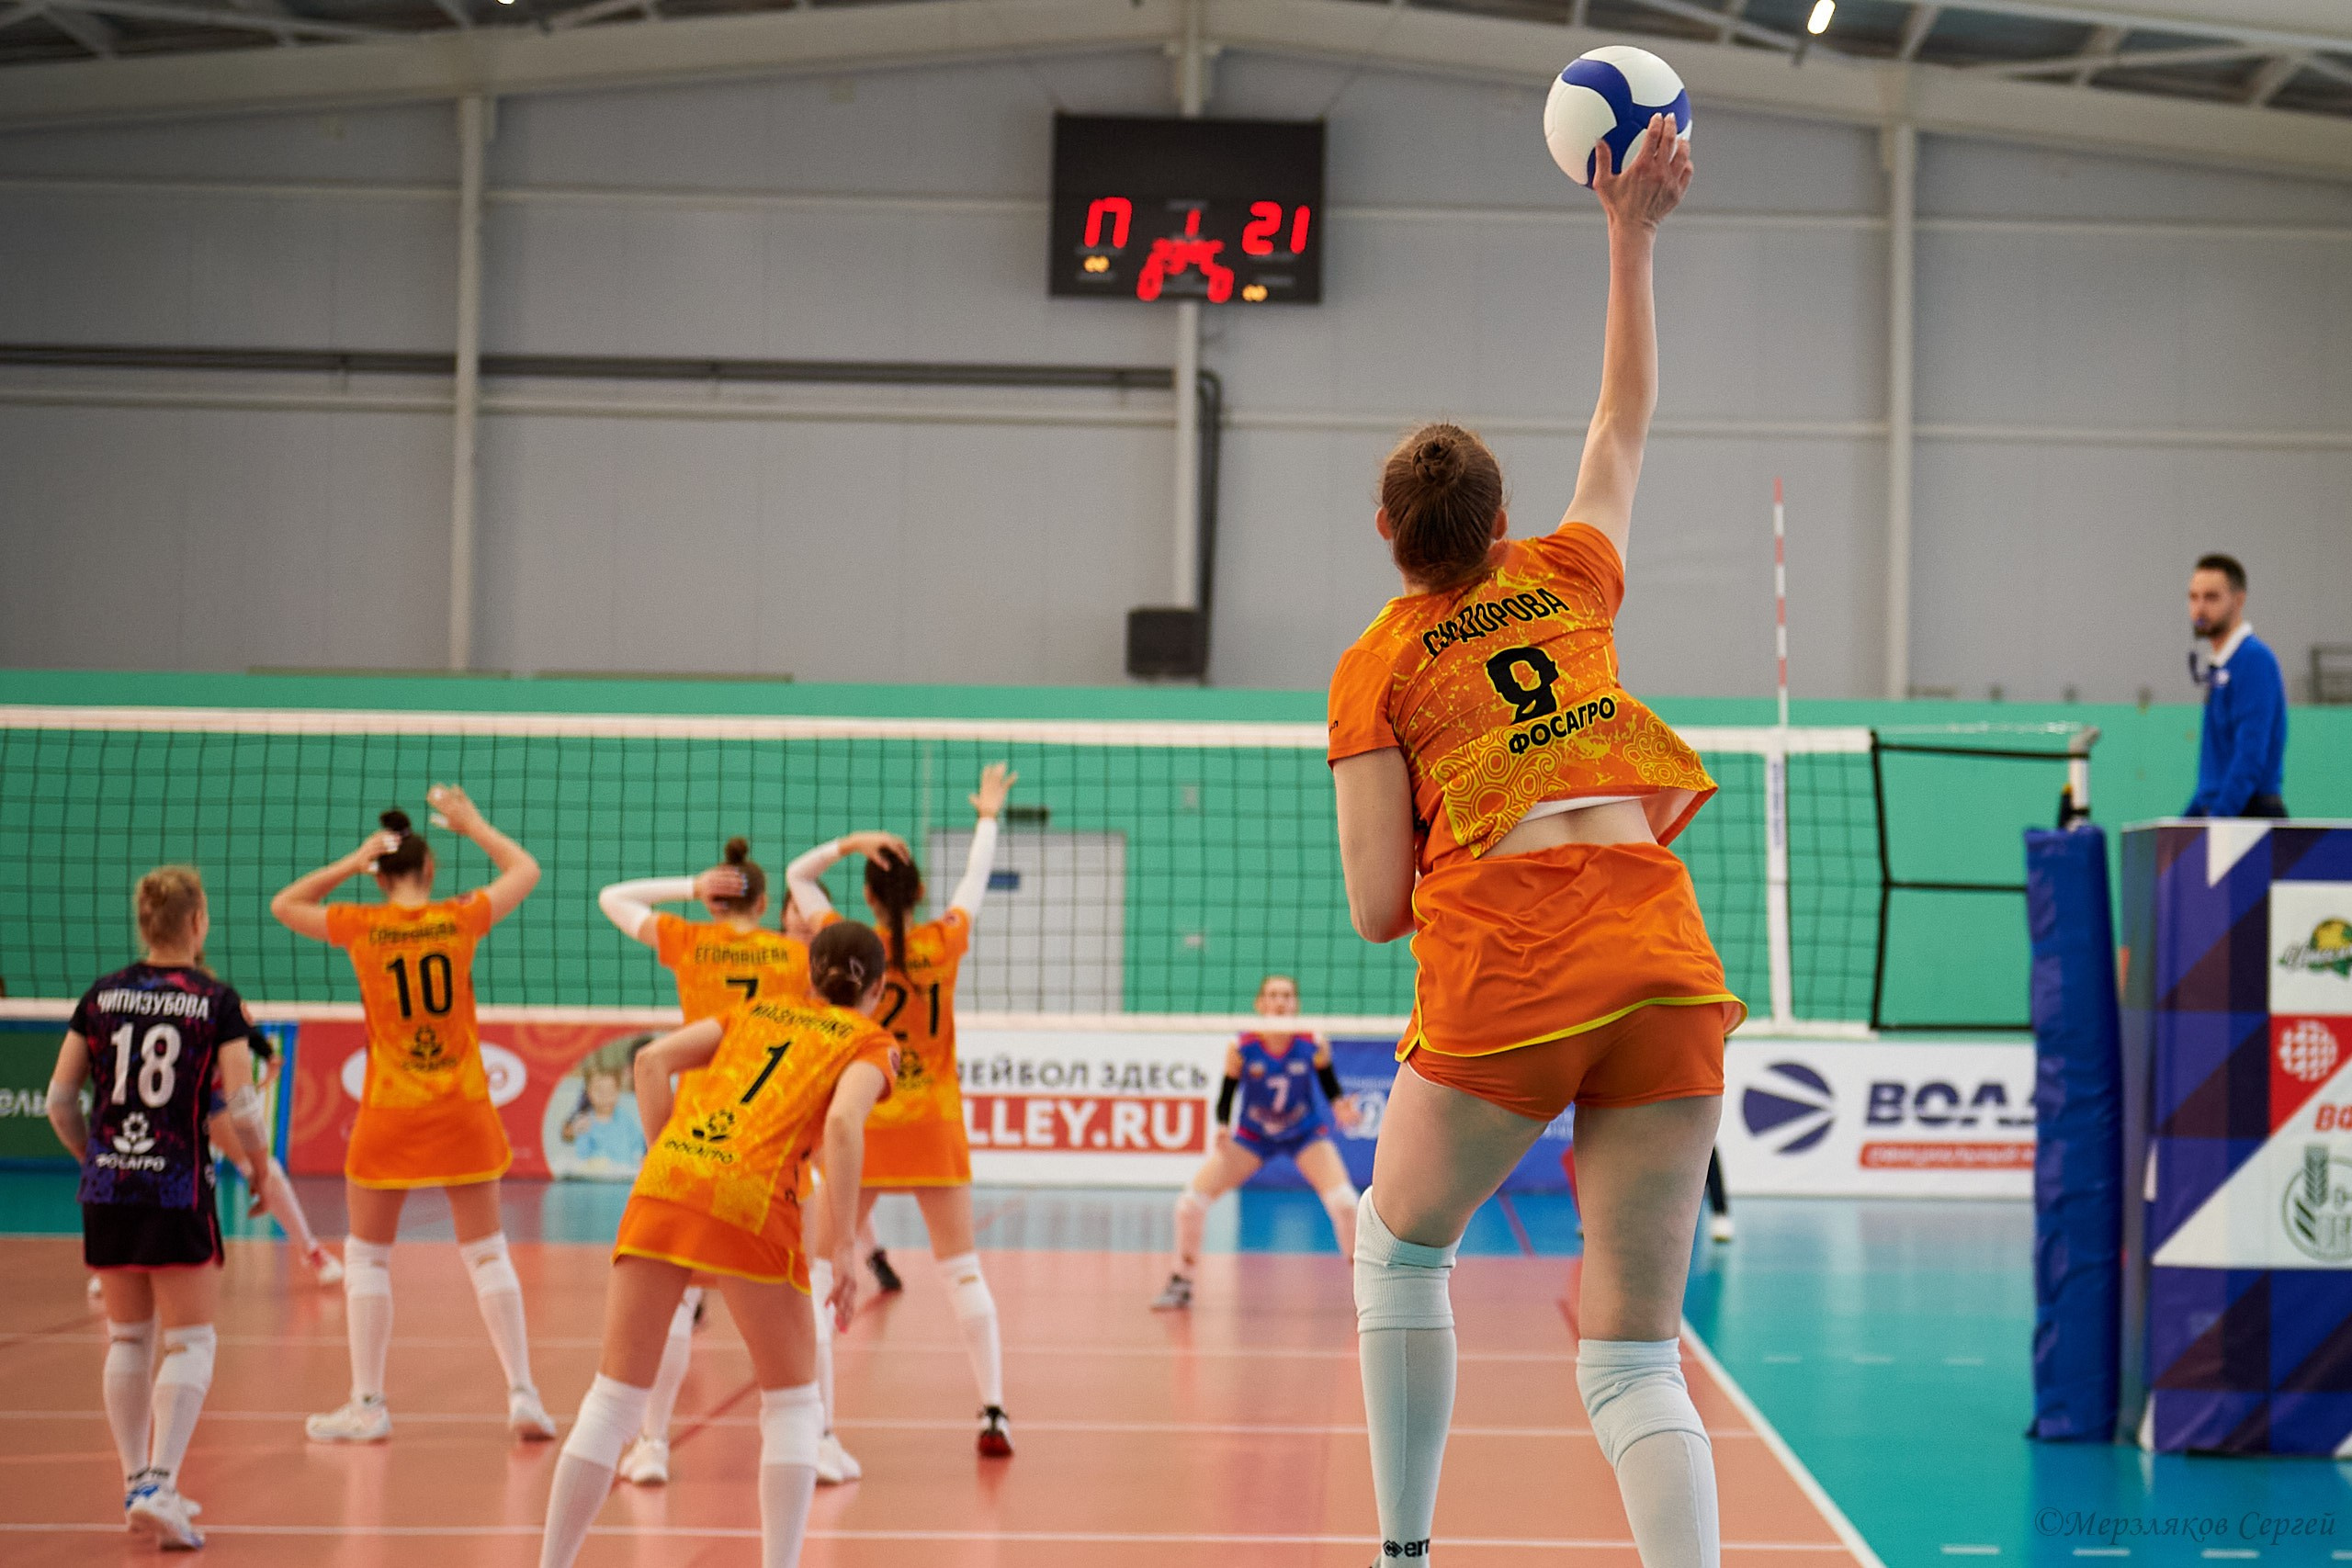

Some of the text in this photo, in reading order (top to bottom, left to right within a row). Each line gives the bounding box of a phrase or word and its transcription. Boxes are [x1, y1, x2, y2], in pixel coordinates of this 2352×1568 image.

[1241, 200, 1311, 255] 21
[1508, 695, 1616, 756] ФОСАГРО
[385, 952, 453, 1019] 10
[882, 980, 939, 1039] 21
[110, 1021, 182, 1109] 18
[739, 1040, 793, 1105] 1
[1102, 1060, 1209, 1093] ЗДЕСЬ
[1266, 1075, 1289, 1113] 7
